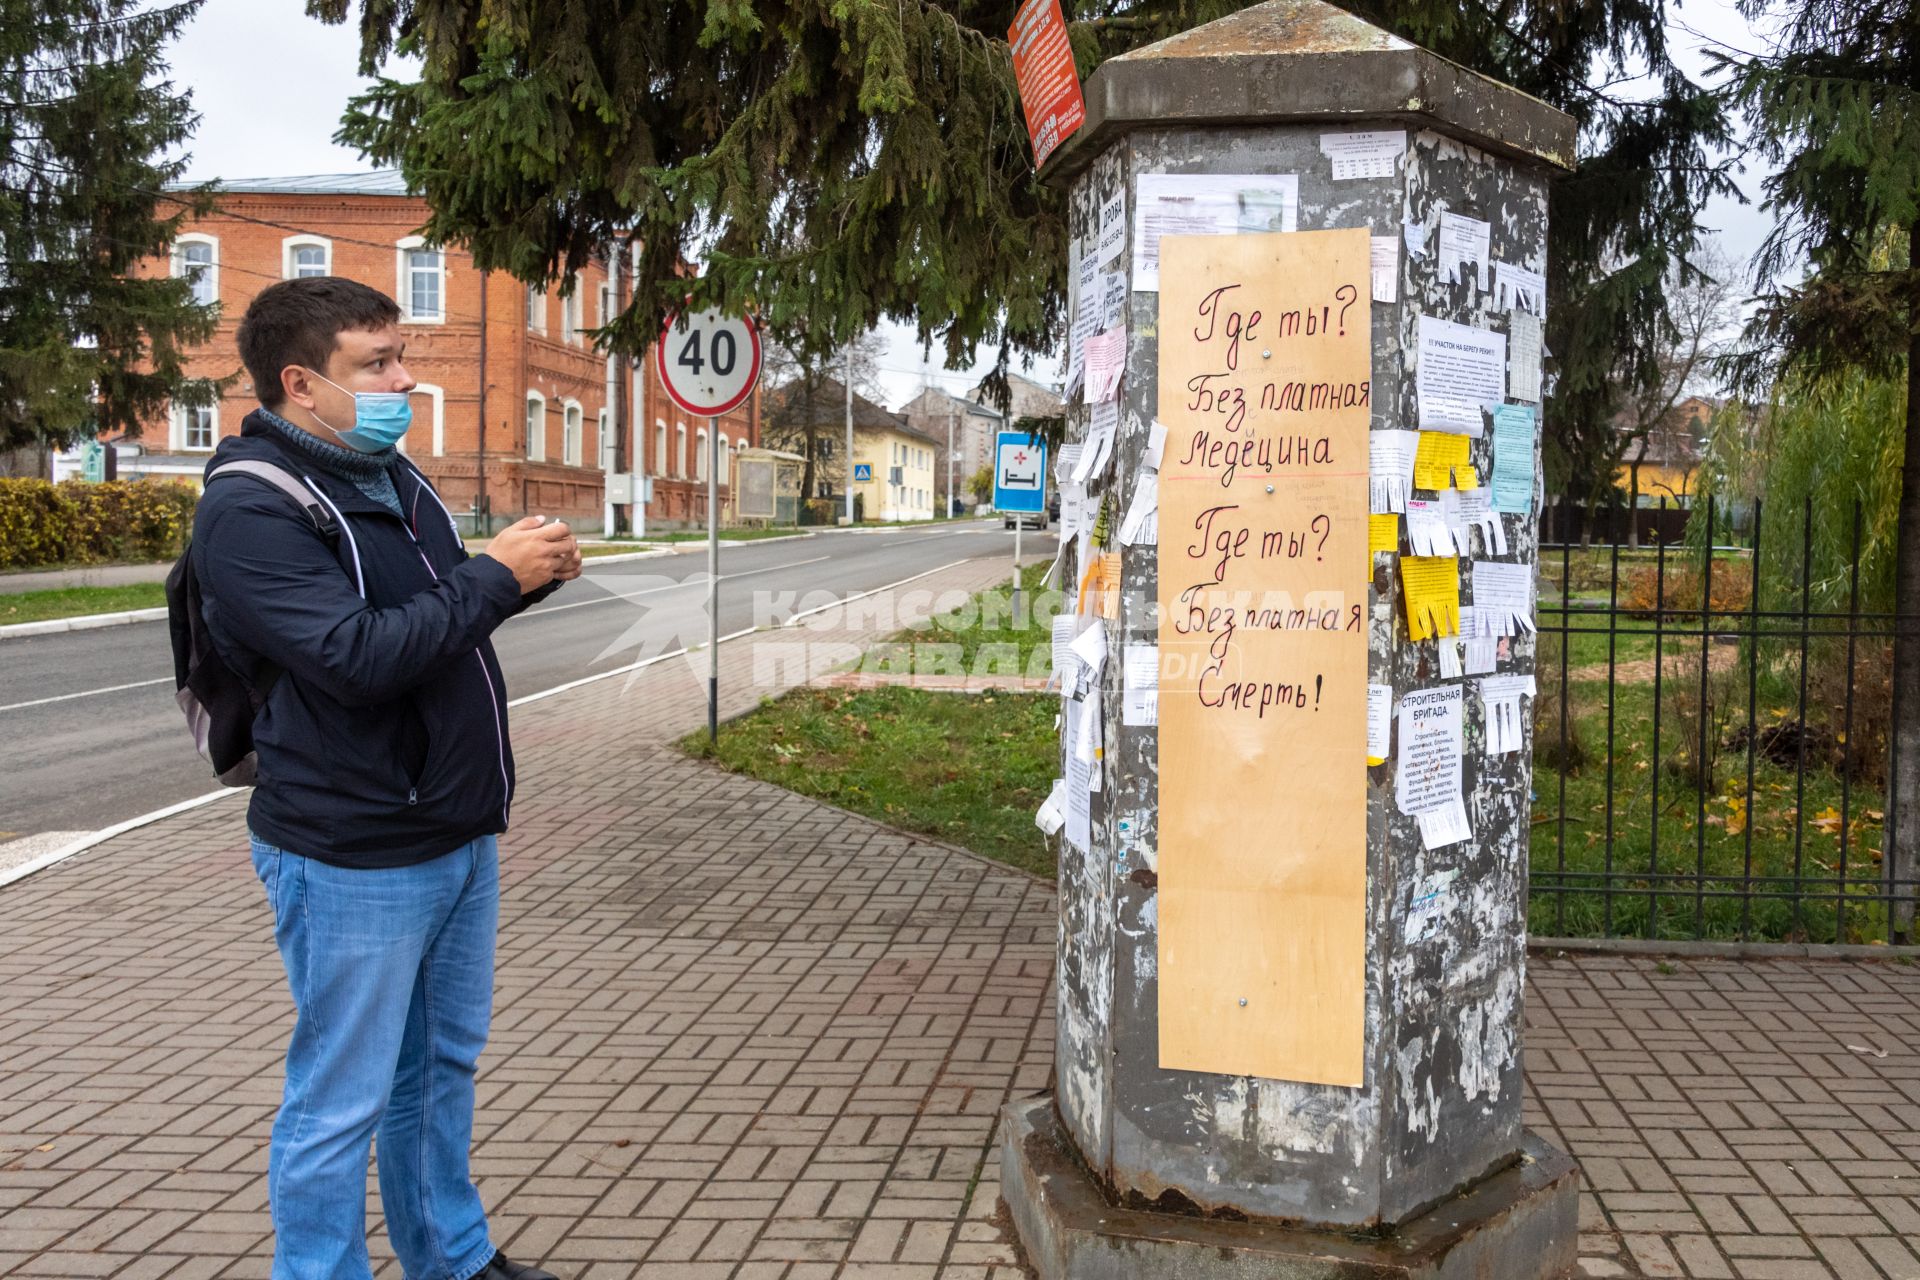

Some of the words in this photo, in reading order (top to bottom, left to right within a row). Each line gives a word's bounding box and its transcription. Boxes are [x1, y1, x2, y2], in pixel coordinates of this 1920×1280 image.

[1103, 199, 1122, 233] ДРОВА
[678, 329, 737, 376] 40
[1194, 284, 1261, 370] Где
[1279, 284, 1357, 338] ты?
[1434, 339, 1455, 350] УЧАСТОК
[1463, 344, 1478, 354] БЕРЕГУ
[1188, 373, 1248, 432] Без
[1260, 378, 1369, 411] платная
[1180, 429, 1333, 488] Медецина
[1188, 505, 1248, 581] Где
[1176, 582, 1235, 658] Без
[1245, 603, 1361, 634] платная
[1198, 660, 1323, 718] Смерть!
[1402, 689, 1460, 708] СТРОИТЕЛЬНАЯ
